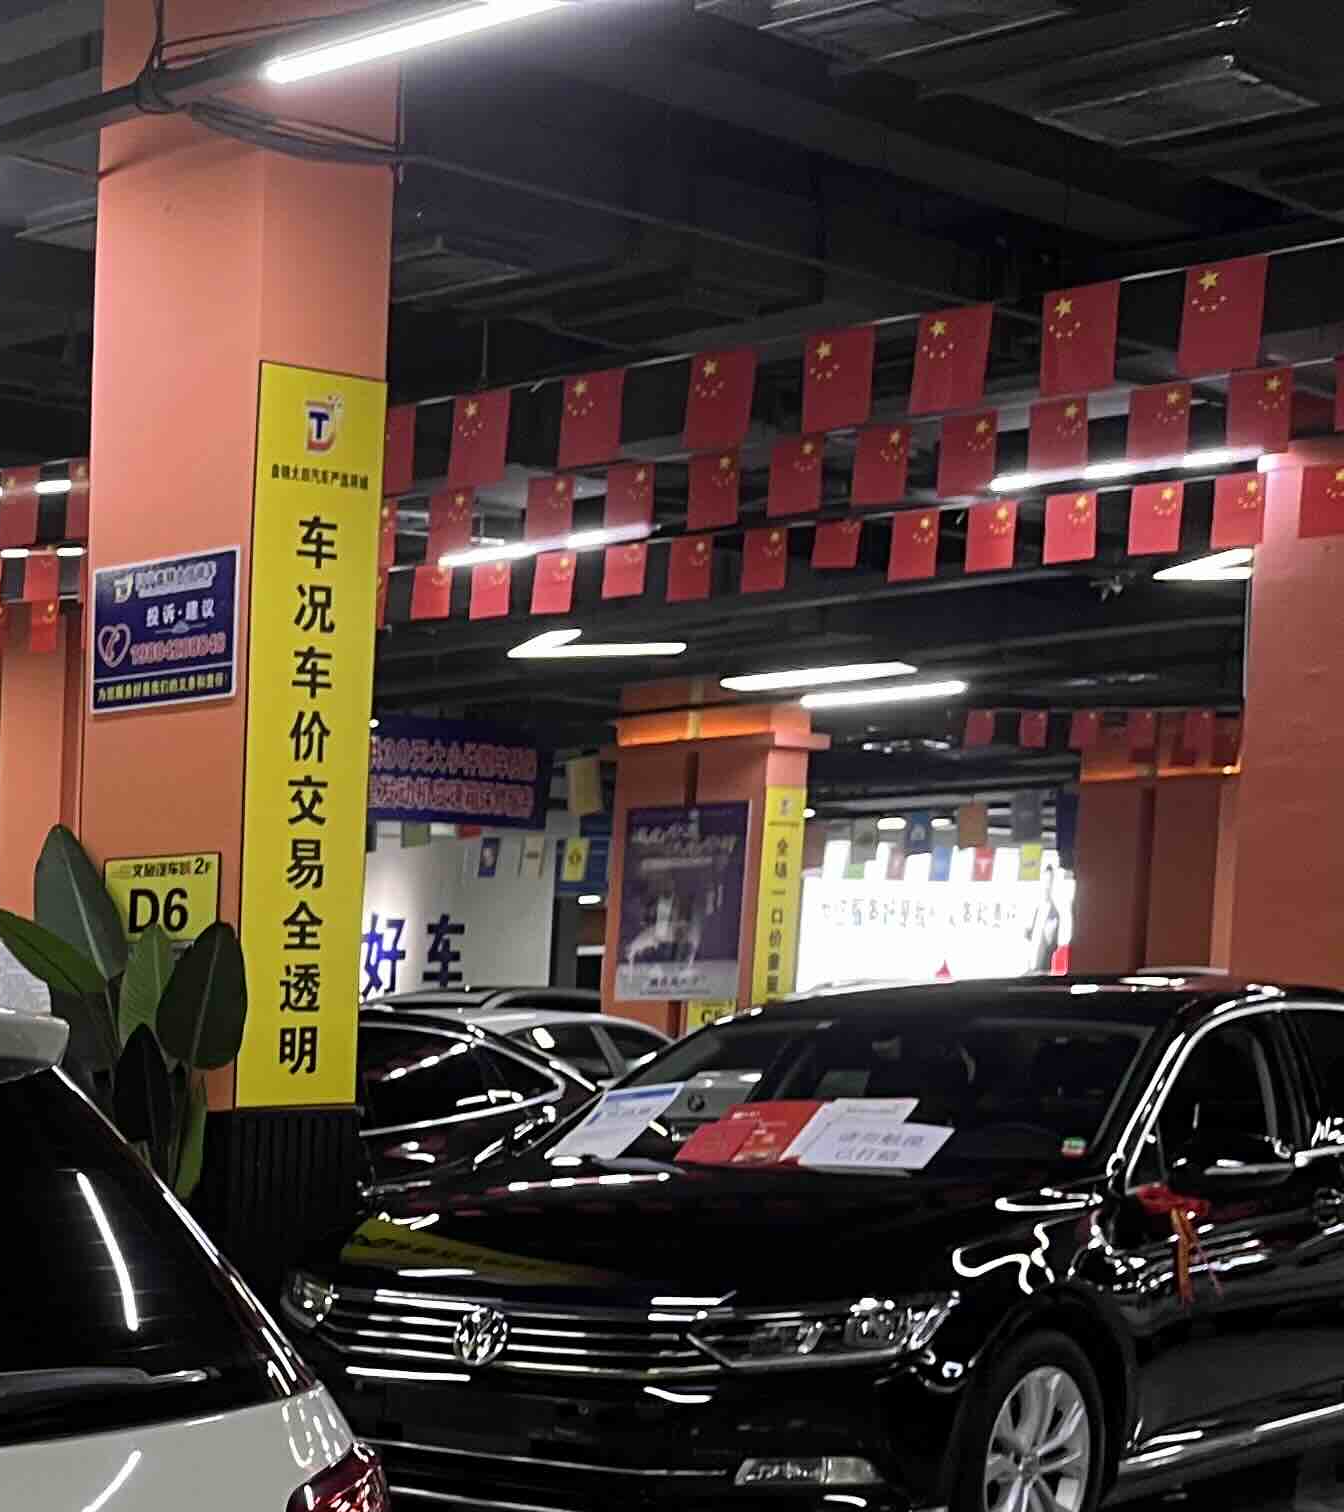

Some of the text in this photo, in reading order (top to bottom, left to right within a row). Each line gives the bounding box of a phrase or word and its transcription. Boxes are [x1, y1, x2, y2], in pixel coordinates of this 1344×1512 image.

[278, 513, 339, 1077] 车况车价交易全透明
[127, 887, 190, 934] D6
[361, 913, 465, 1000] 好车
